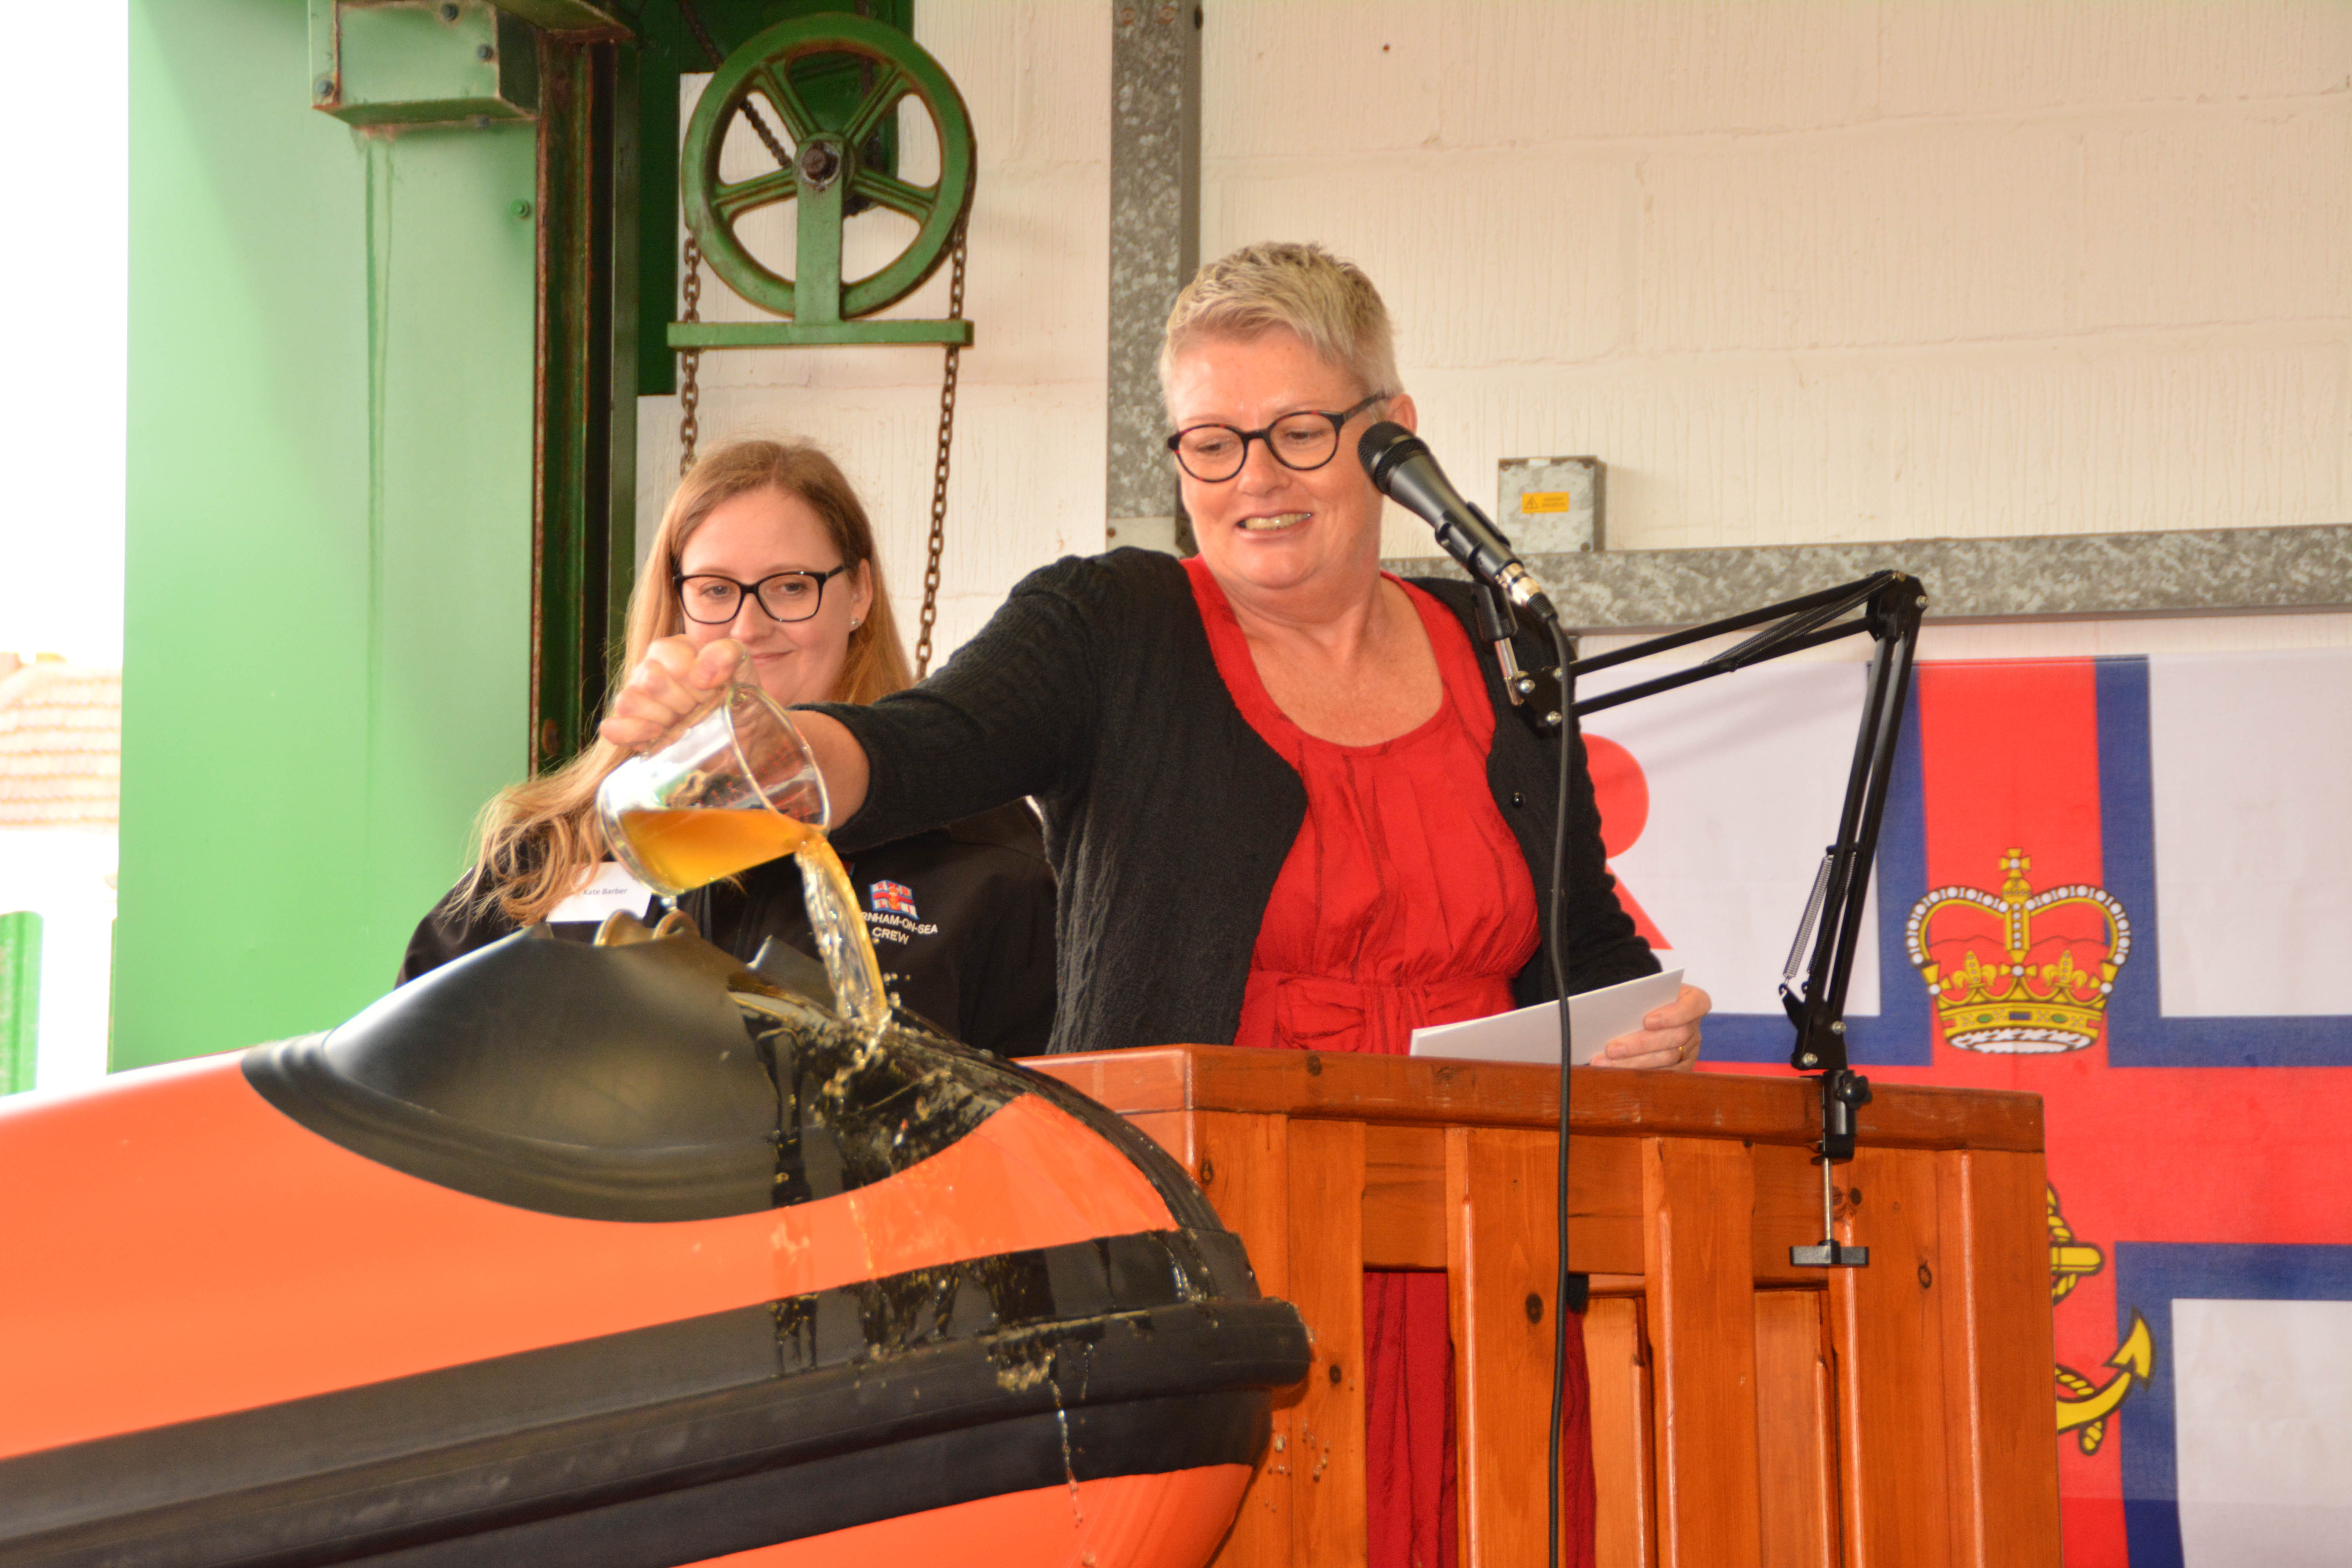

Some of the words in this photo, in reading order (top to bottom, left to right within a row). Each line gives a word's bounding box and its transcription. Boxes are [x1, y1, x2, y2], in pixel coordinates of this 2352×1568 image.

[902, 886, 909, 896] N
[861, 911, 938, 935] RNHAM-ON-SEA
[872, 926, 909, 945] CREW
